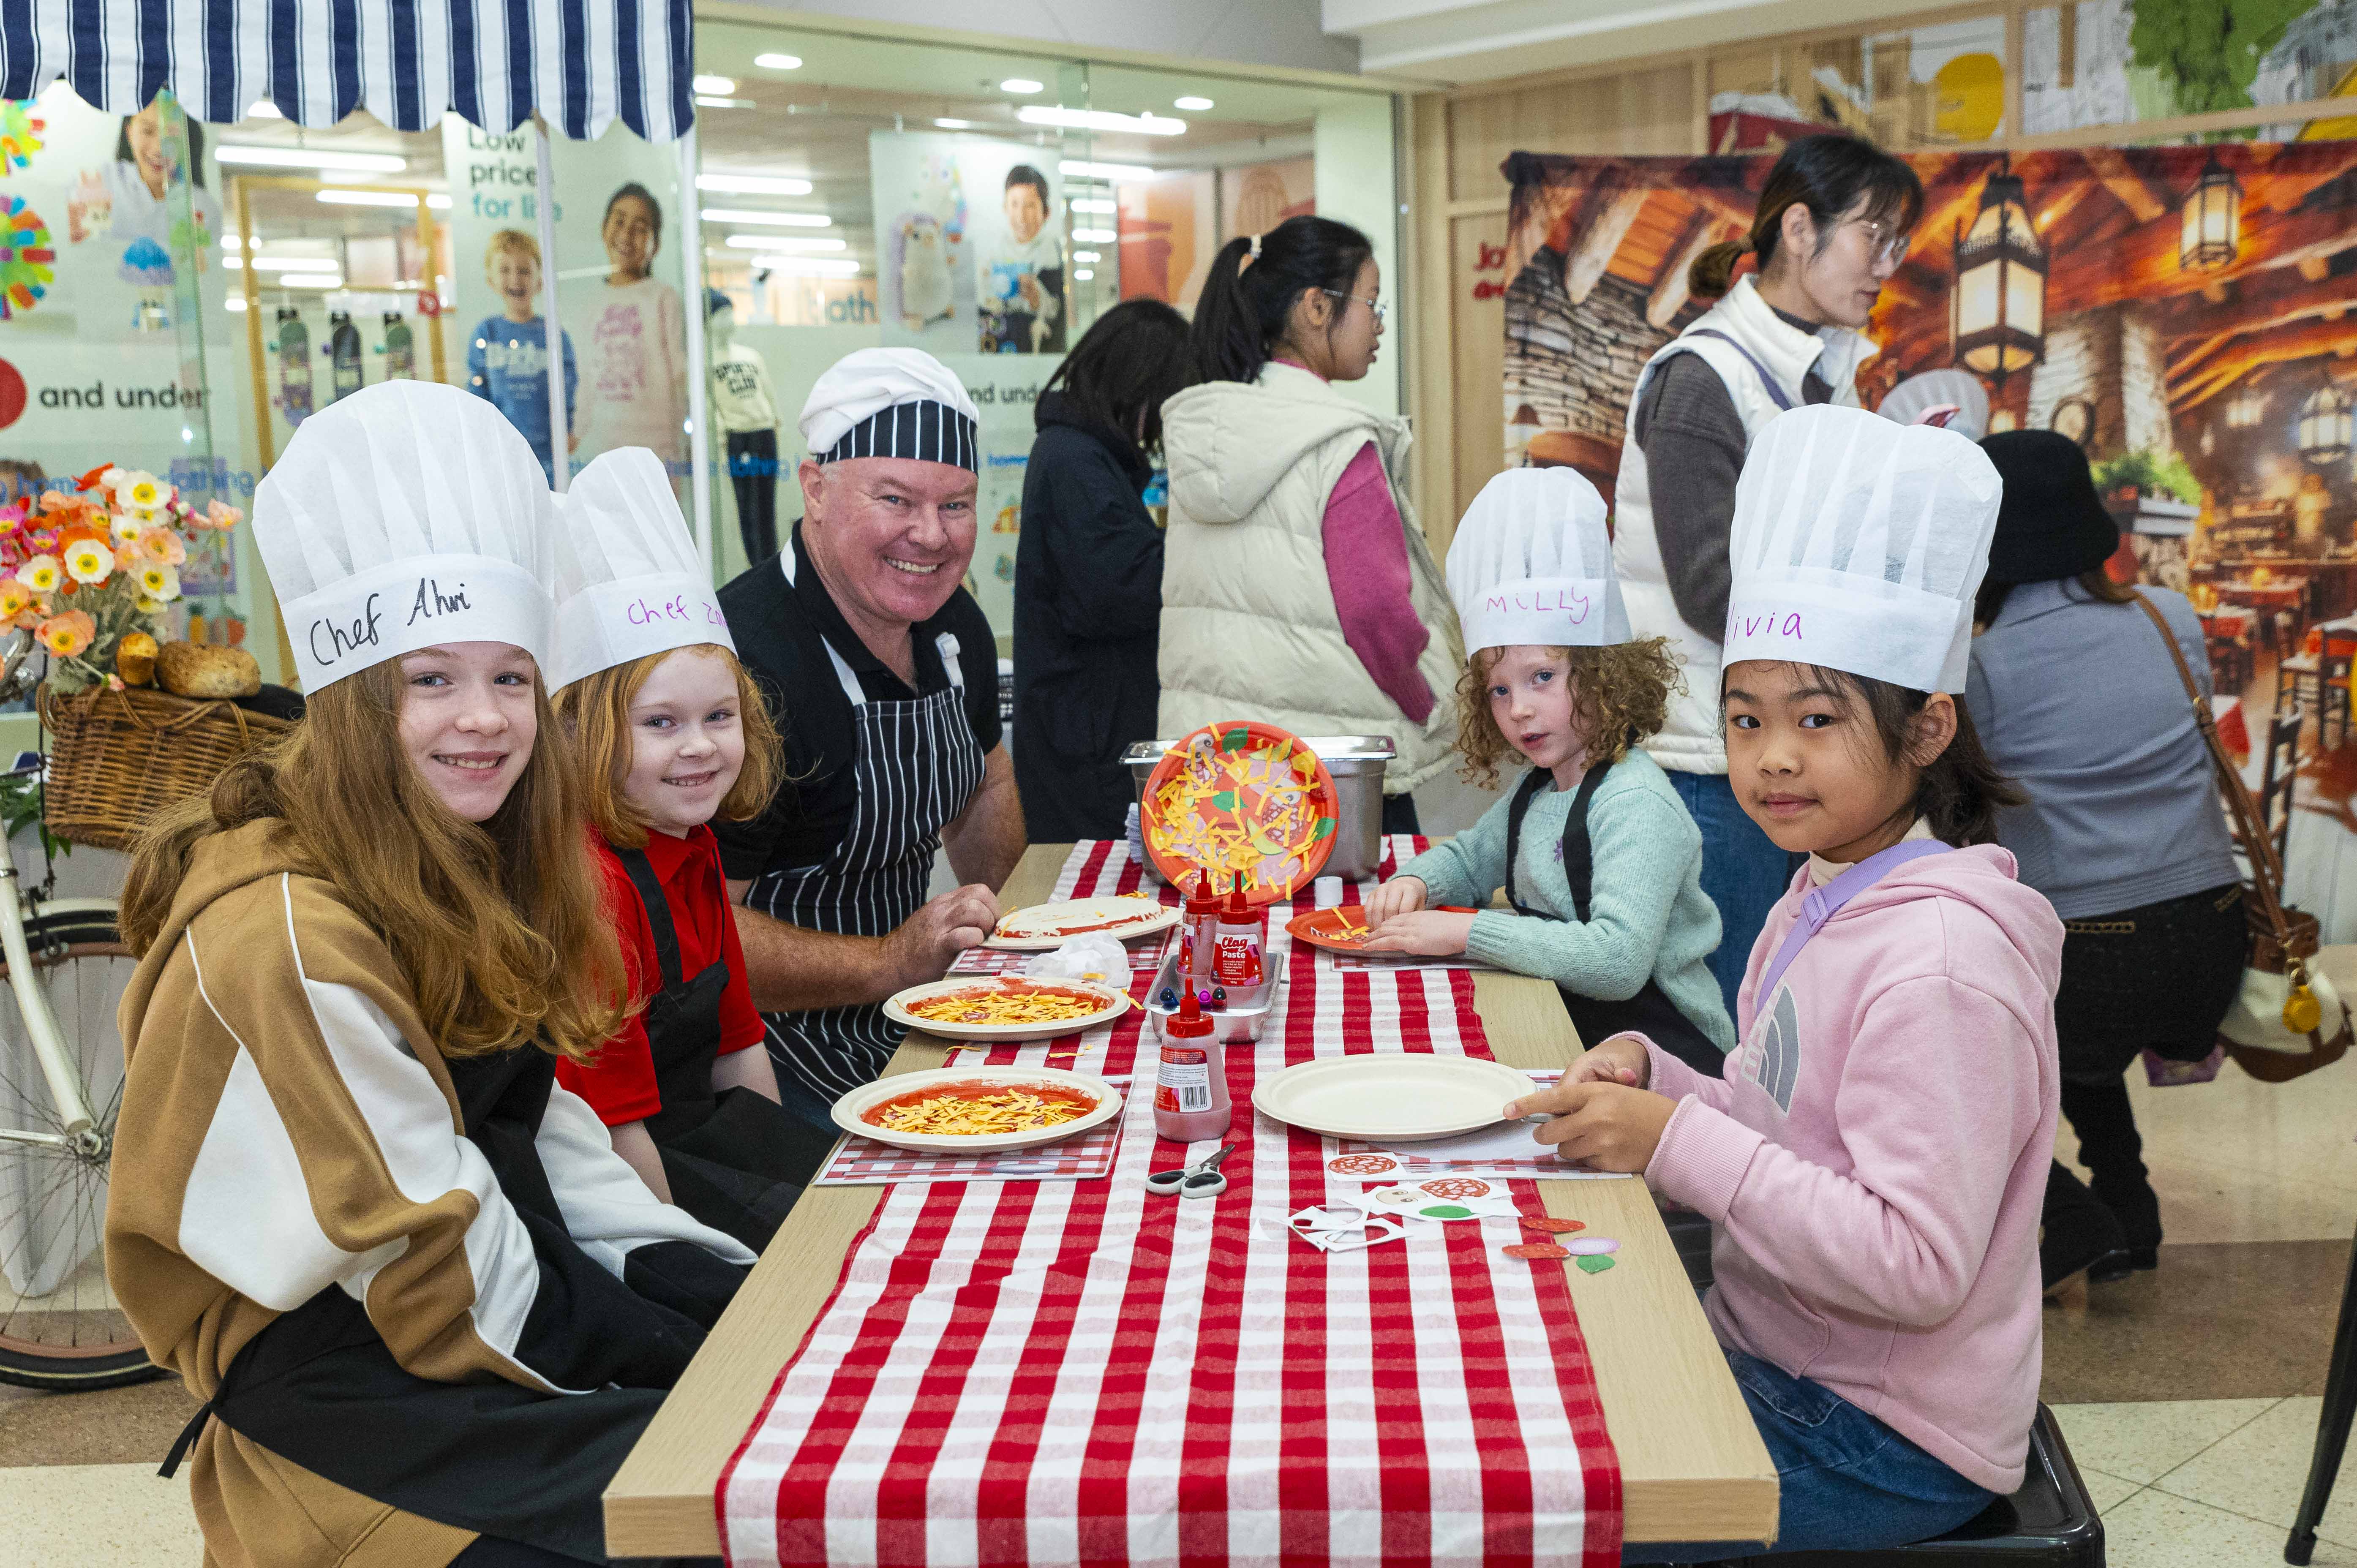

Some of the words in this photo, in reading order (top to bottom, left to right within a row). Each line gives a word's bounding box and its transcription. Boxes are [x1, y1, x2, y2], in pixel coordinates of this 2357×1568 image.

[470, 158, 555, 188] price
[472, 192, 513, 217] for
[520, 193, 564, 223] lie
[40, 380, 104, 408] and
[968, 380, 995, 403] nd
[310, 593, 381, 666] Chef
[1725, 602, 1802, 646] livia
[1221, 936, 1249, 951] Clag
